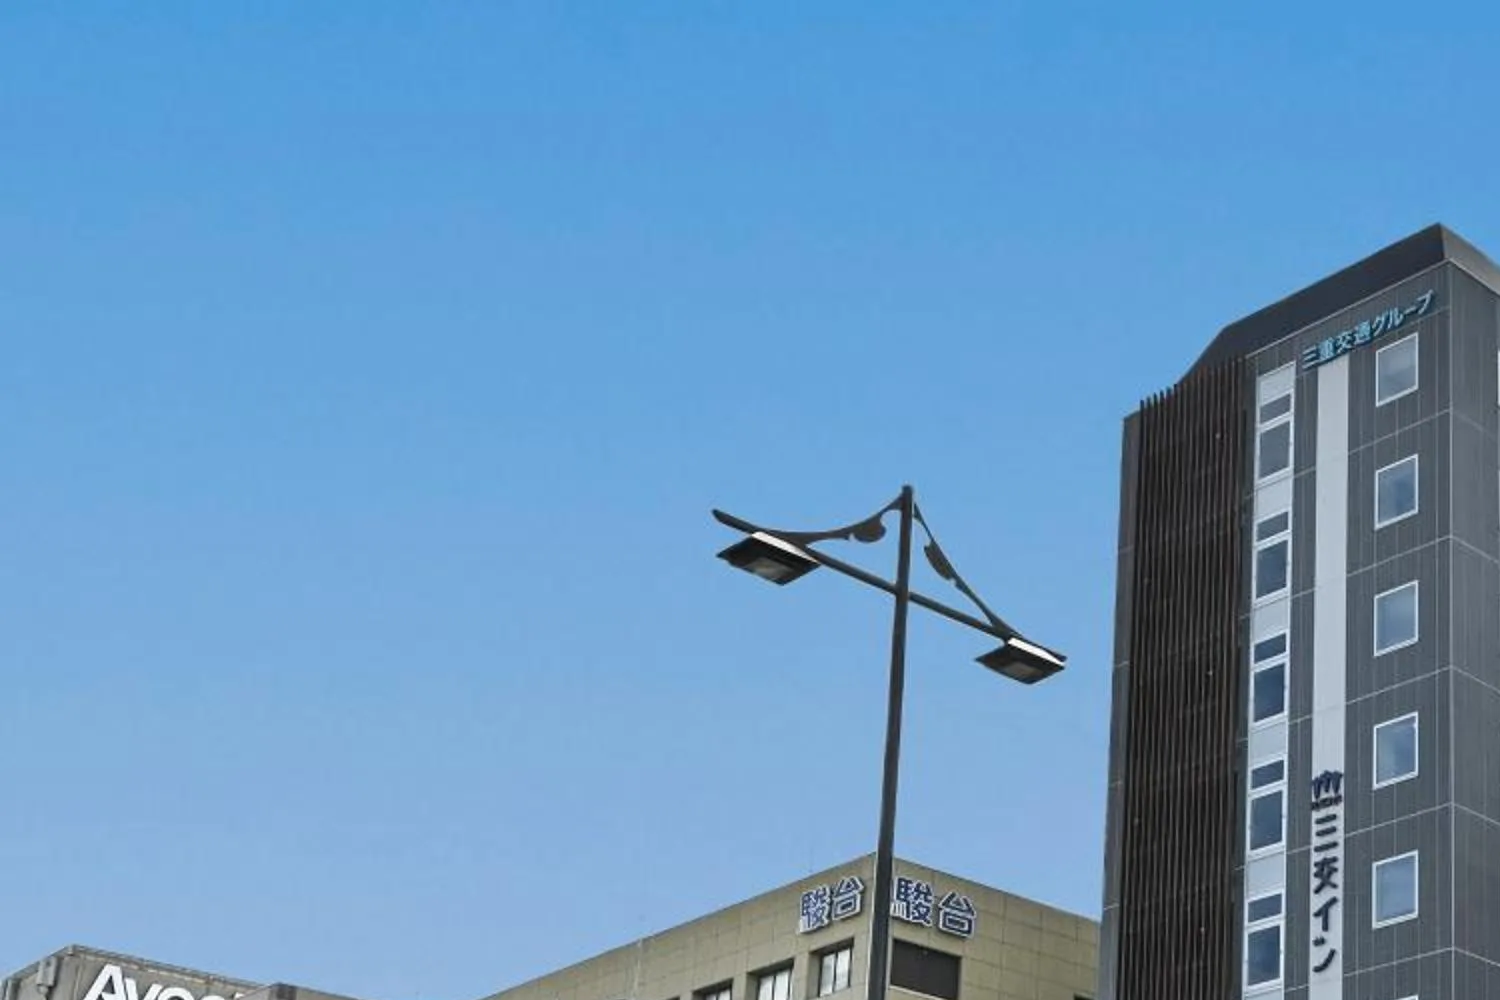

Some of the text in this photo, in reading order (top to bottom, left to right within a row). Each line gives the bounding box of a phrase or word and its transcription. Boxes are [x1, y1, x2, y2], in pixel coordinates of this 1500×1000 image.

[799, 875, 864, 934] 駿台
[890, 876, 977, 939] 駿台
[1313, 813, 1339, 974] 三交イン
